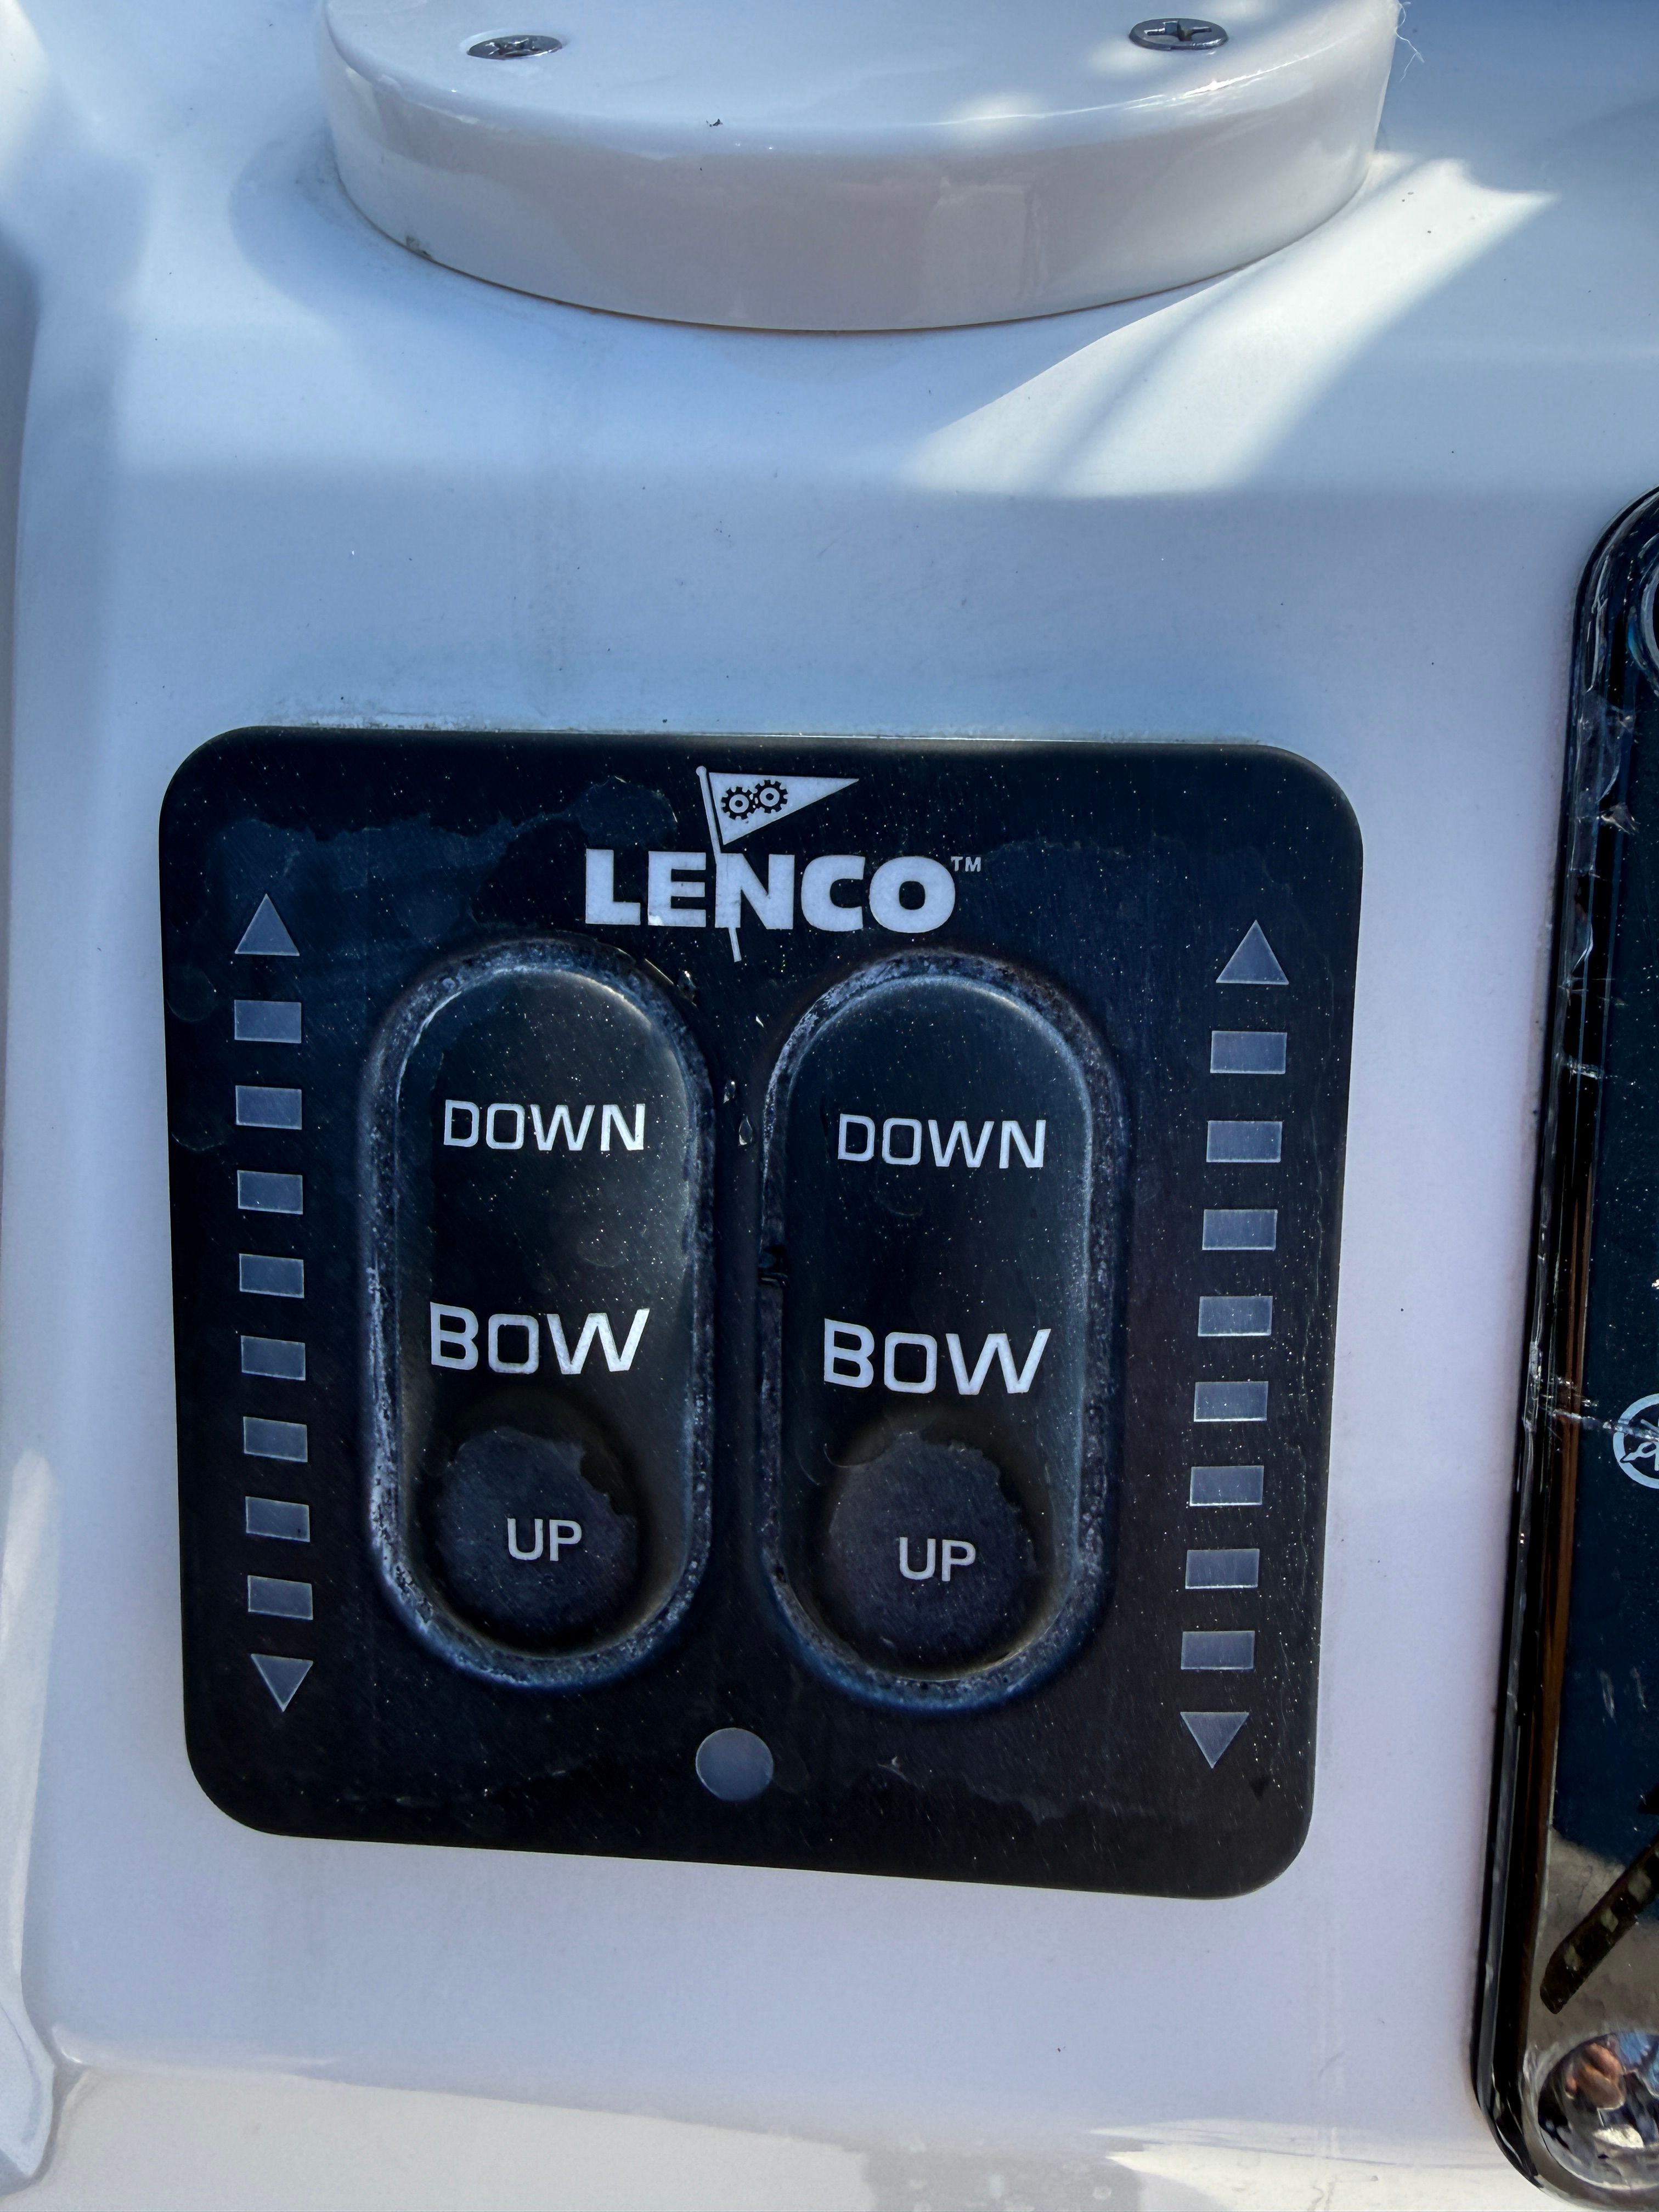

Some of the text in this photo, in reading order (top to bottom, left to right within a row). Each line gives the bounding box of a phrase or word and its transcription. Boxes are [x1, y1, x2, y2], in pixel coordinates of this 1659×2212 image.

[584, 848, 956, 934] LENCO
[442, 1098, 647, 1153] DOWN
[837, 1113, 1047, 1170] DOWN
[428, 1301, 651, 1375] BOW
[822, 1317, 1053, 1396] BOW
[506, 1517, 583, 1562] UP
[898, 1536, 976, 1583] UP
